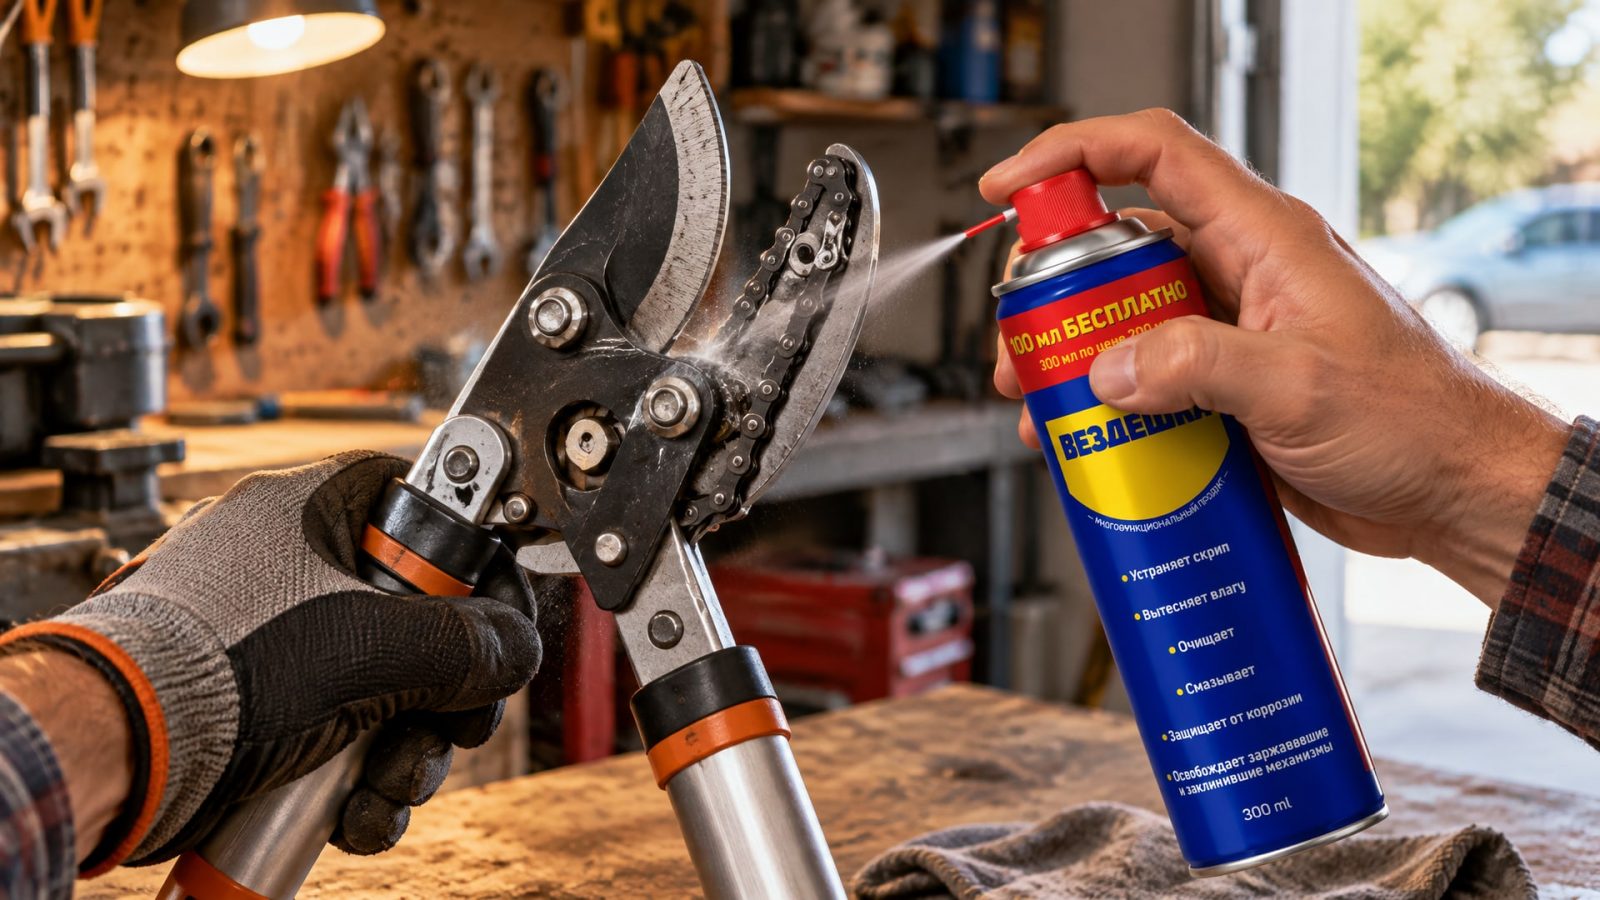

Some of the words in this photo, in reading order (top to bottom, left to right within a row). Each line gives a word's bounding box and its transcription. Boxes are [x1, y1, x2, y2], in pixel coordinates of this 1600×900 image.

[1010, 332, 1034, 356] 100
[1036, 327, 1063, 348] мл
[1061, 280, 1188, 340] БЕСПЛАТНО
[1039, 355, 1060, 371] 300
[1062, 351, 1078, 365] мл
[1079, 345, 1094, 359] по
[1129, 555, 1190, 582] Устраняет
[1193, 543, 1230, 563] скрип
[1142, 593, 1208, 621] Вытесняет
[1210, 580, 1246, 600] влагу
[1178, 627, 1235, 653] Очищает
[1185, 665, 1255, 695] Смазывает
[1168, 718, 1227, 742] Защищает
[1230, 712, 1244, 725] от
[1246, 693, 1303, 720] коррозии
[1173, 756, 1245, 782] Освобождает
[1178, 786, 1186, 796] и
[1186, 767, 1263, 796] заклинившие
[1265, 742, 1334, 774] механизмы
[1242, 803, 1271, 821] 300
[1274, 797, 1293, 813] ml
